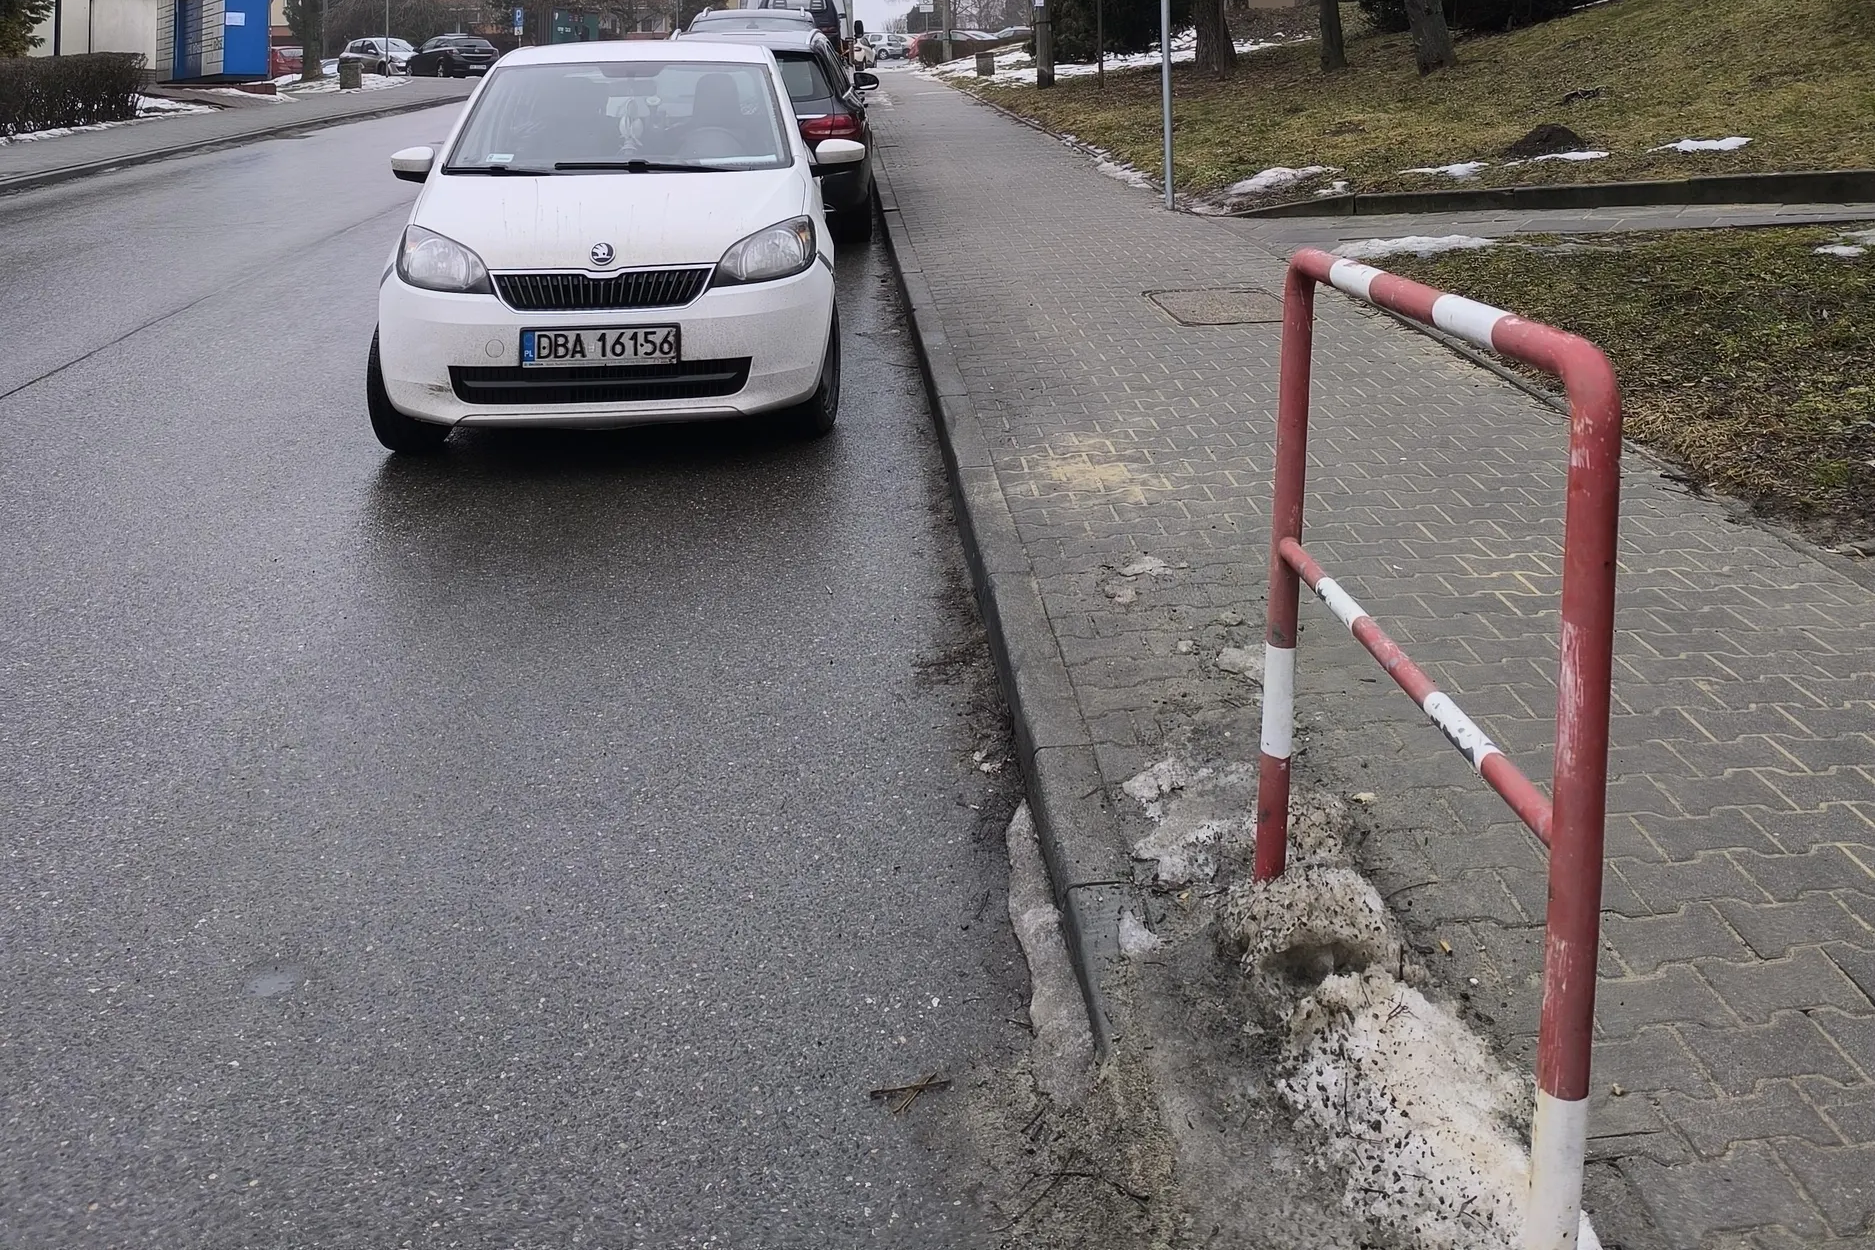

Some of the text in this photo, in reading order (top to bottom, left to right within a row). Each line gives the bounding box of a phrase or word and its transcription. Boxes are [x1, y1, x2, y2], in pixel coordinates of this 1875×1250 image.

[515, 9, 521, 22] P
[537, 329, 675, 359] DBA 16156
[524, 350, 534, 358] PL
